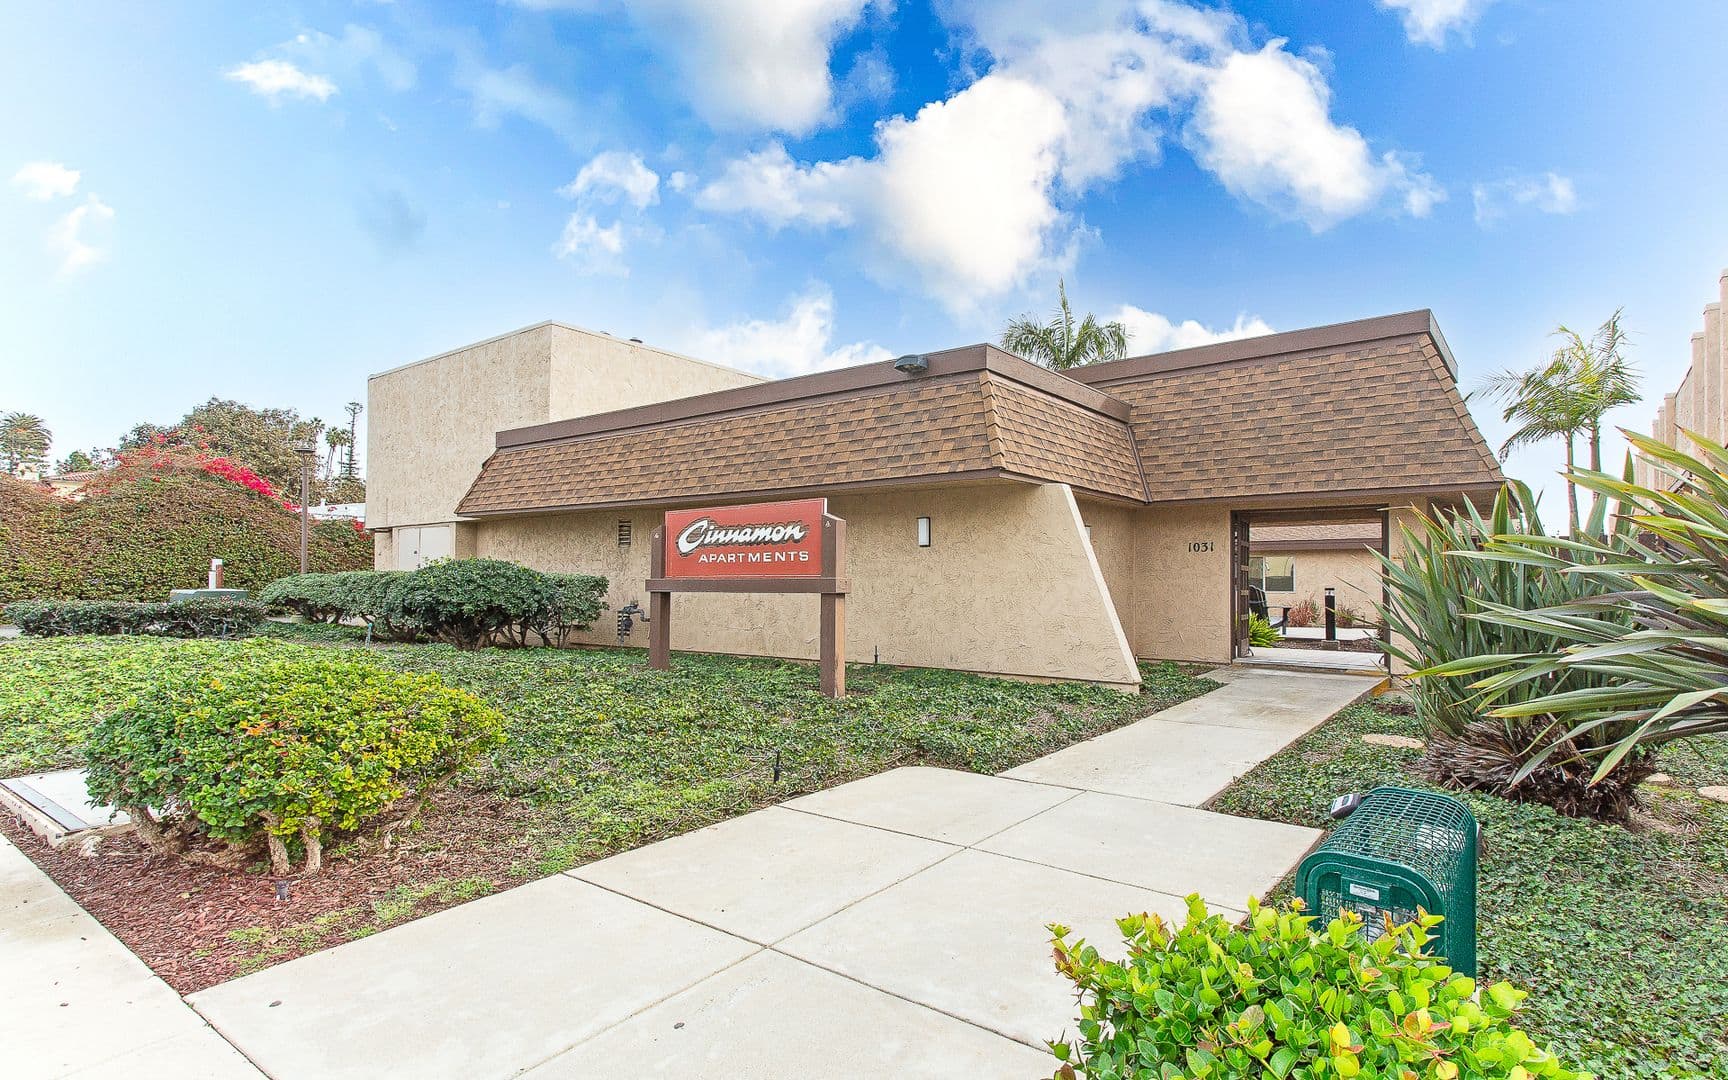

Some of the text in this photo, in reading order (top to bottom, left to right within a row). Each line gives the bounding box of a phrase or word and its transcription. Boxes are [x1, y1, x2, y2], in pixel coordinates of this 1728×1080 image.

[676, 518, 808, 556] Cinnamon
[1188, 541, 1214, 553] 1031
[698, 551, 809, 563] APARTMENTS
